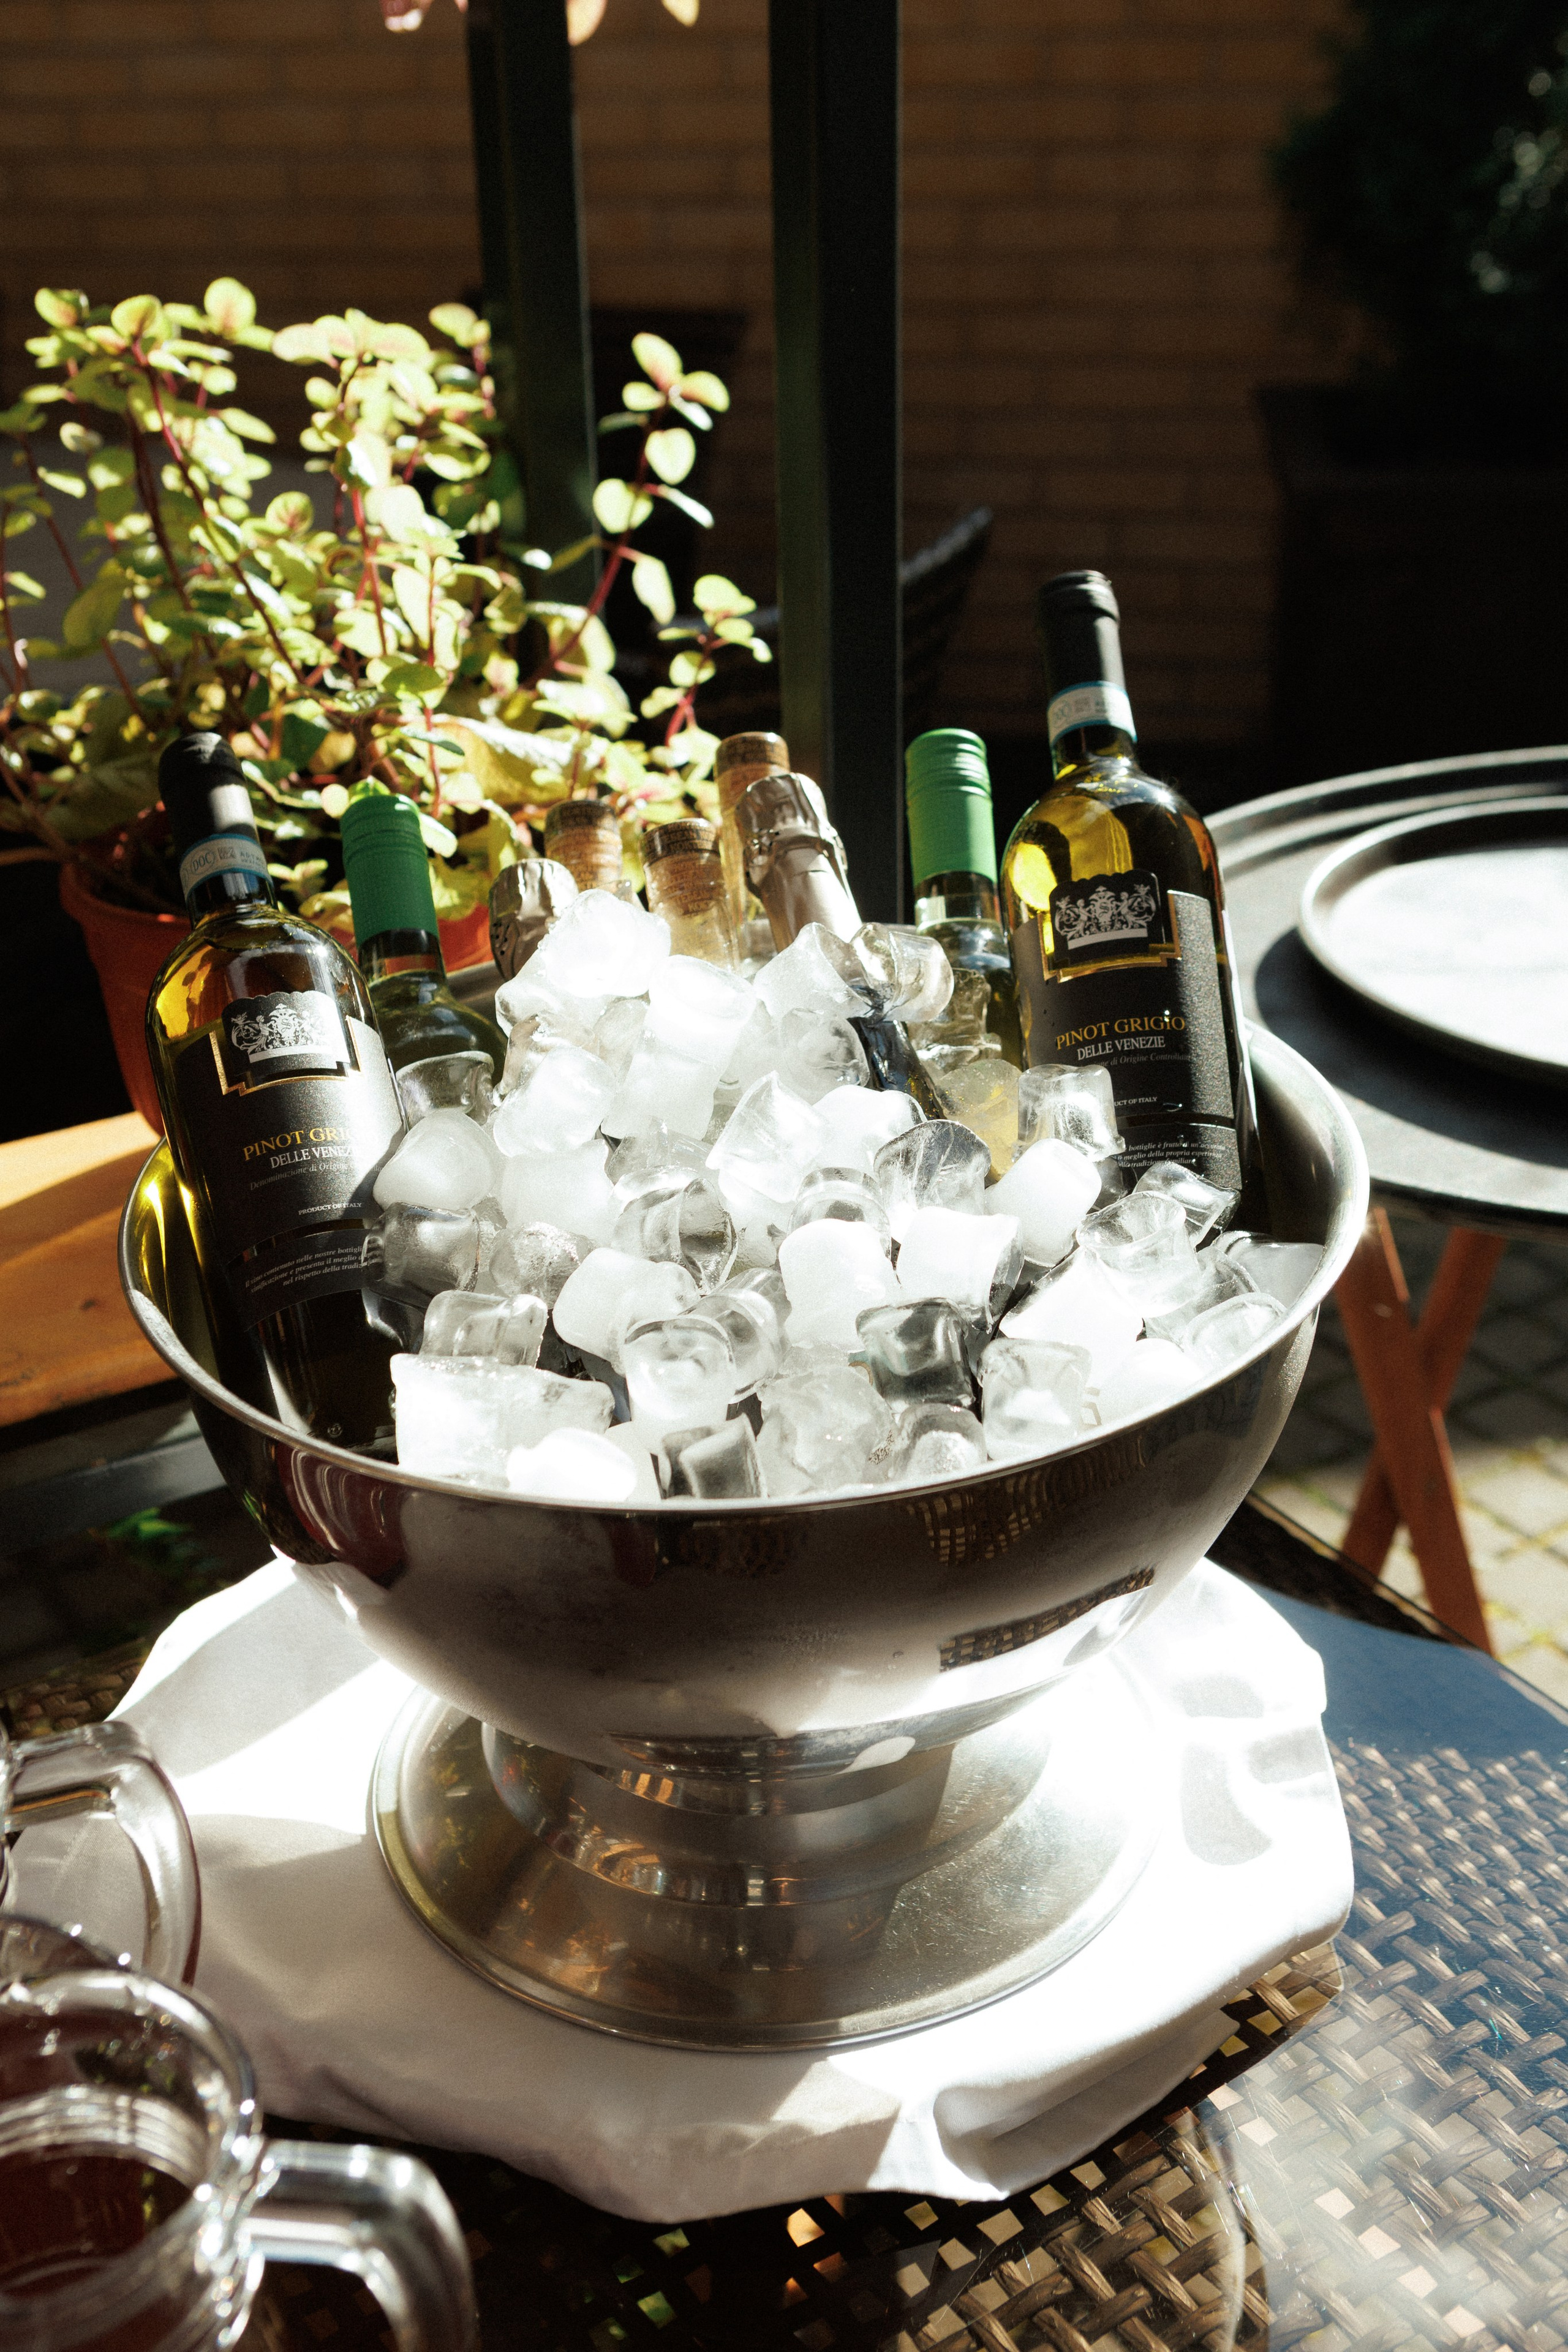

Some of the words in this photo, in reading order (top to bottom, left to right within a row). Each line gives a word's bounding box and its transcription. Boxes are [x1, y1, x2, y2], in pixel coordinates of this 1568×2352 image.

[192, 851, 212, 871] DOC
[1056, 1021, 1110, 1050] PINOT
[1114, 1016, 1186, 1033] GRIGIO
[1077, 1041, 1113, 1060] DELLE
[1114, 1036, 1166, 1052] VENEZIE
[1110, 1056, 1118, 1066] di
[1120, 1054, 1149, 1065] Origine
[243, 1130, 304, 1161] PINOT
[1123, 1152, 1146, 1161] meglio
[1166, 1149, 1190, 1158] propria
[1128, 1142, 1156, 1152] bottiglie
[1162, 1141, 1182, 1150] frutto
[270, 1148, 311, 1169] DELLE
[311, 1146, 358, 1159] VENEZ
[1131, 1159, 1156, 1167] tradizio
[250, 1167, 307, 1190] Denominazione
[309, 1163, 317, 1172] di
[318, 1162, 347, 1172] Origine
[298, 1204, 331, 1216] PRODUCT
[251, 1275, 263, 1284] vino
[264, 1261, 295, 1276] contenuto
[296, 1254, 313, 1264] nelle
[314, 1249, 336, 1259] nostre
[251, 1272, 288, 1293] vinificazione
[295, 1260, 325, 1274] presenta
[333, 1254, 356, 1263] meglio
[283, 1276, 293, 1286] nel
[295, 1270, 321, 1281] rispetto
[322, 1265, 340, 1273] della
